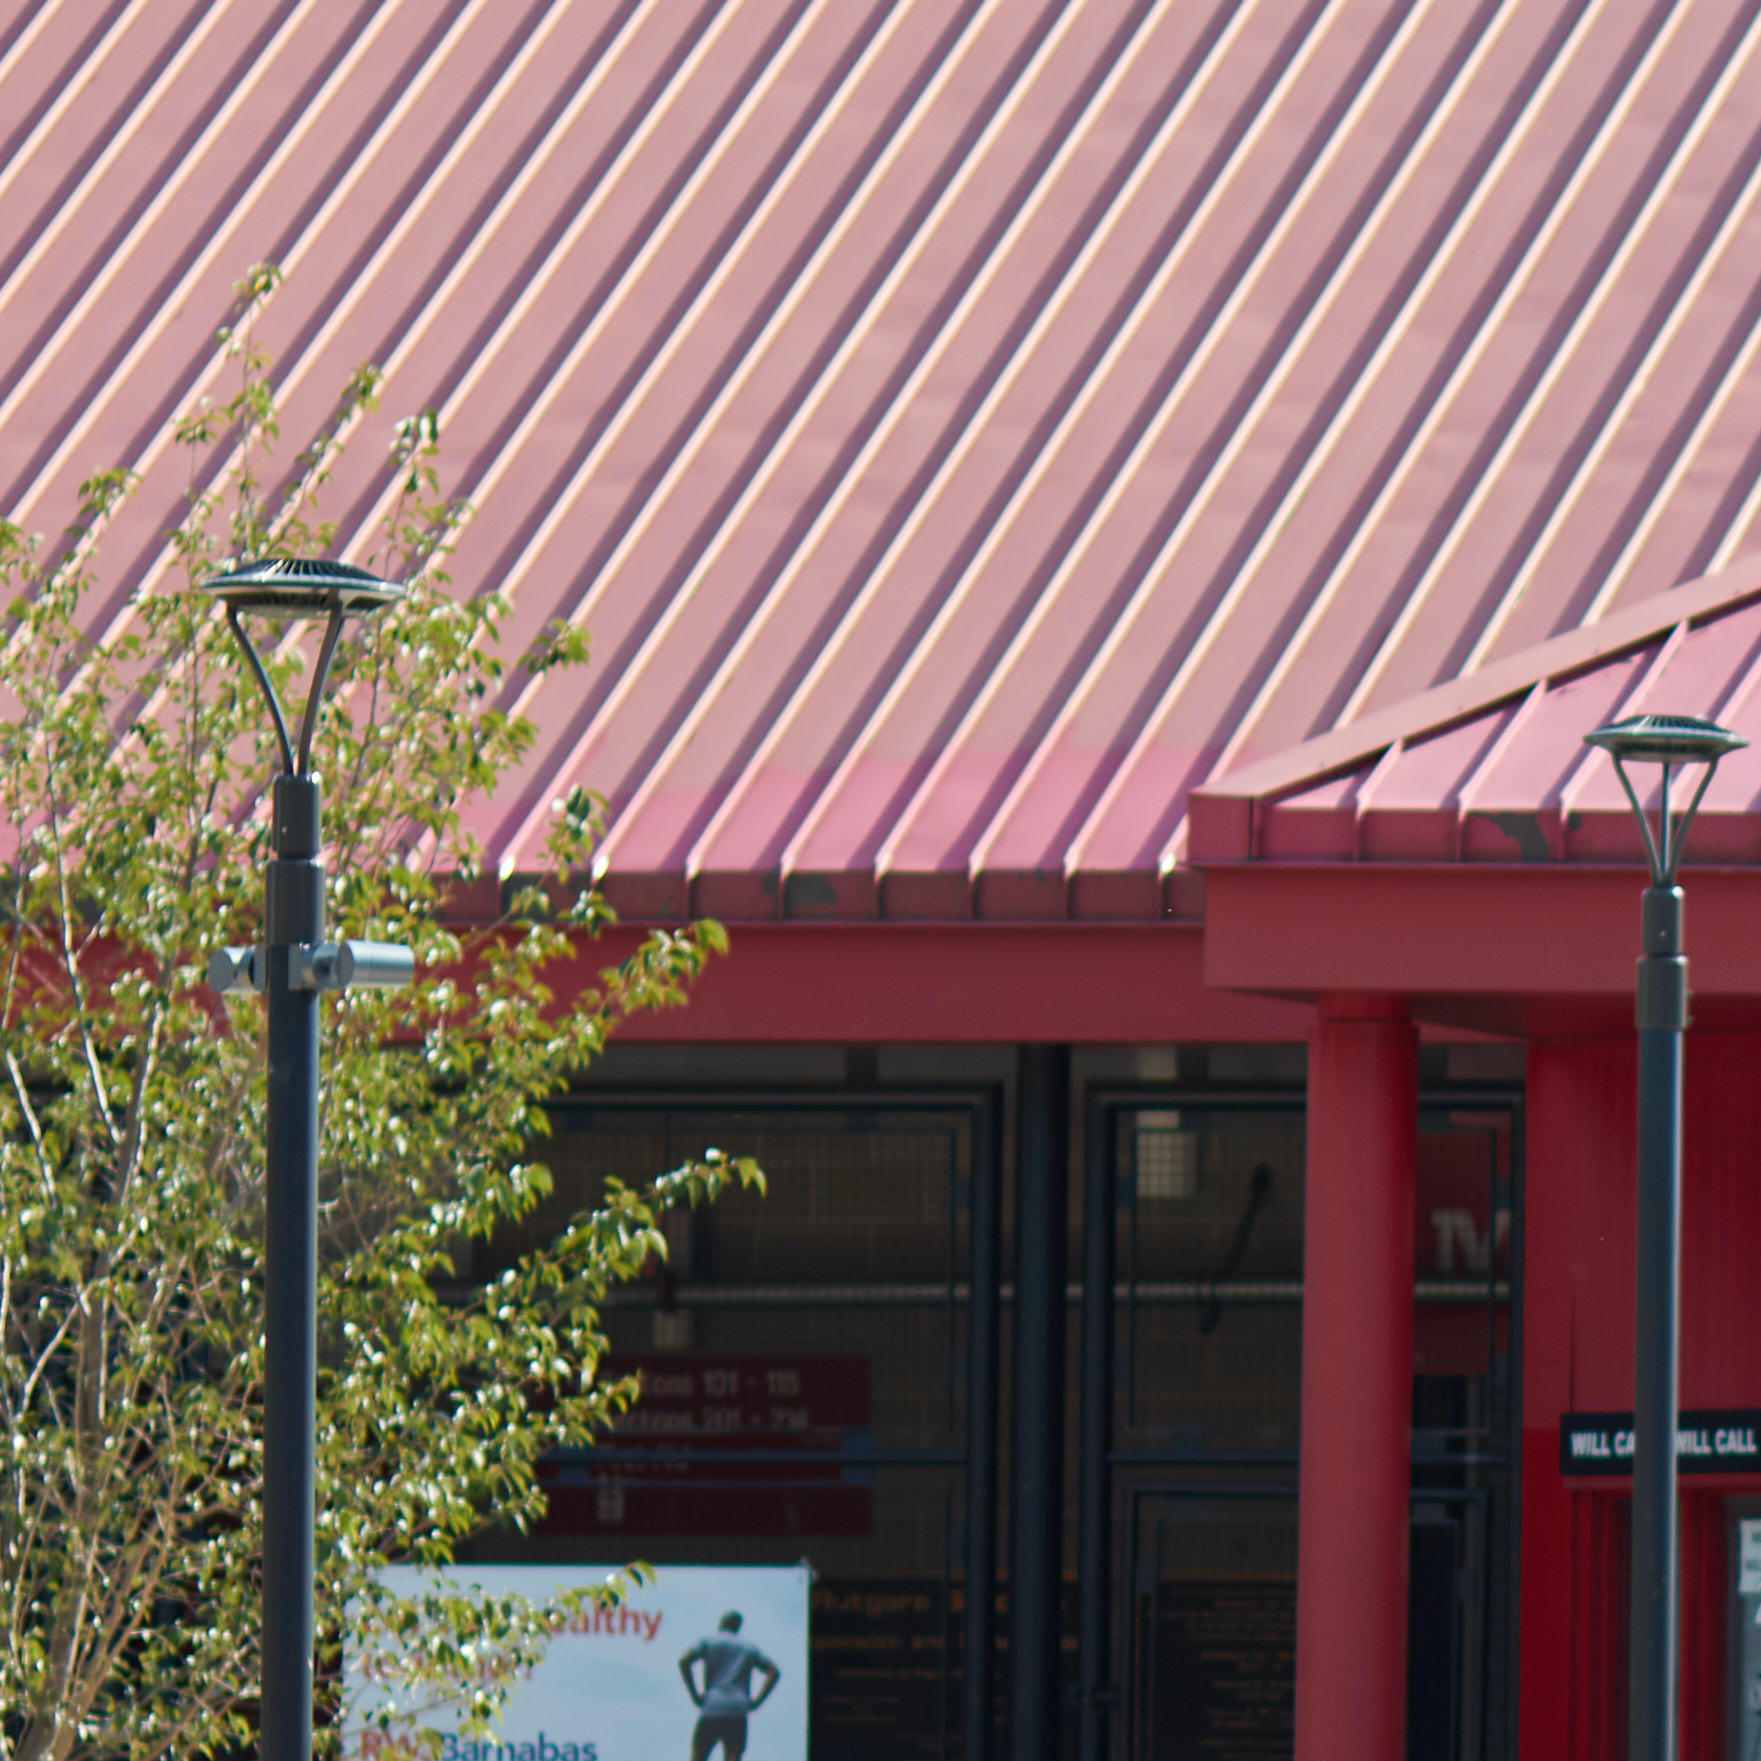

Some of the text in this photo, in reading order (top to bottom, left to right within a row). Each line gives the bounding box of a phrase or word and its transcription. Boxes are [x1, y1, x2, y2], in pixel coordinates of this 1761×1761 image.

[1572, 1431, 1636, 1457] WILL CA
[1674, 1428, 1757, 1455] WILL CALL
